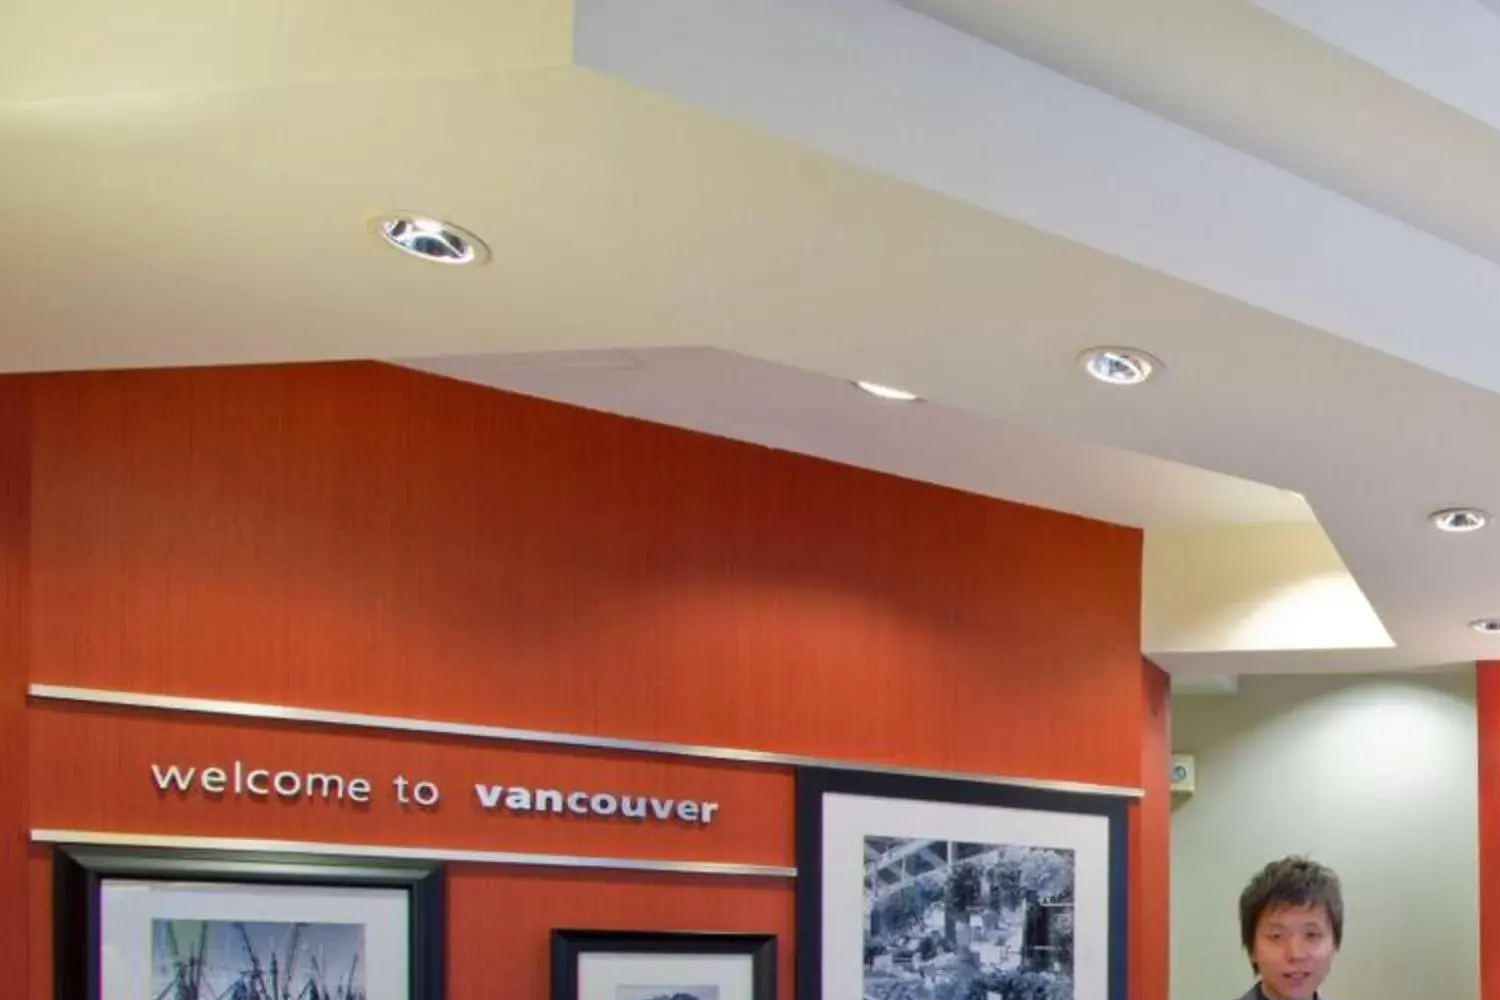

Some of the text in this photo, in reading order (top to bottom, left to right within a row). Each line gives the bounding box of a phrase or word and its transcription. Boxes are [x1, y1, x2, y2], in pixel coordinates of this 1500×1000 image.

[151, 760, 719, 823] welcome to vancouver
